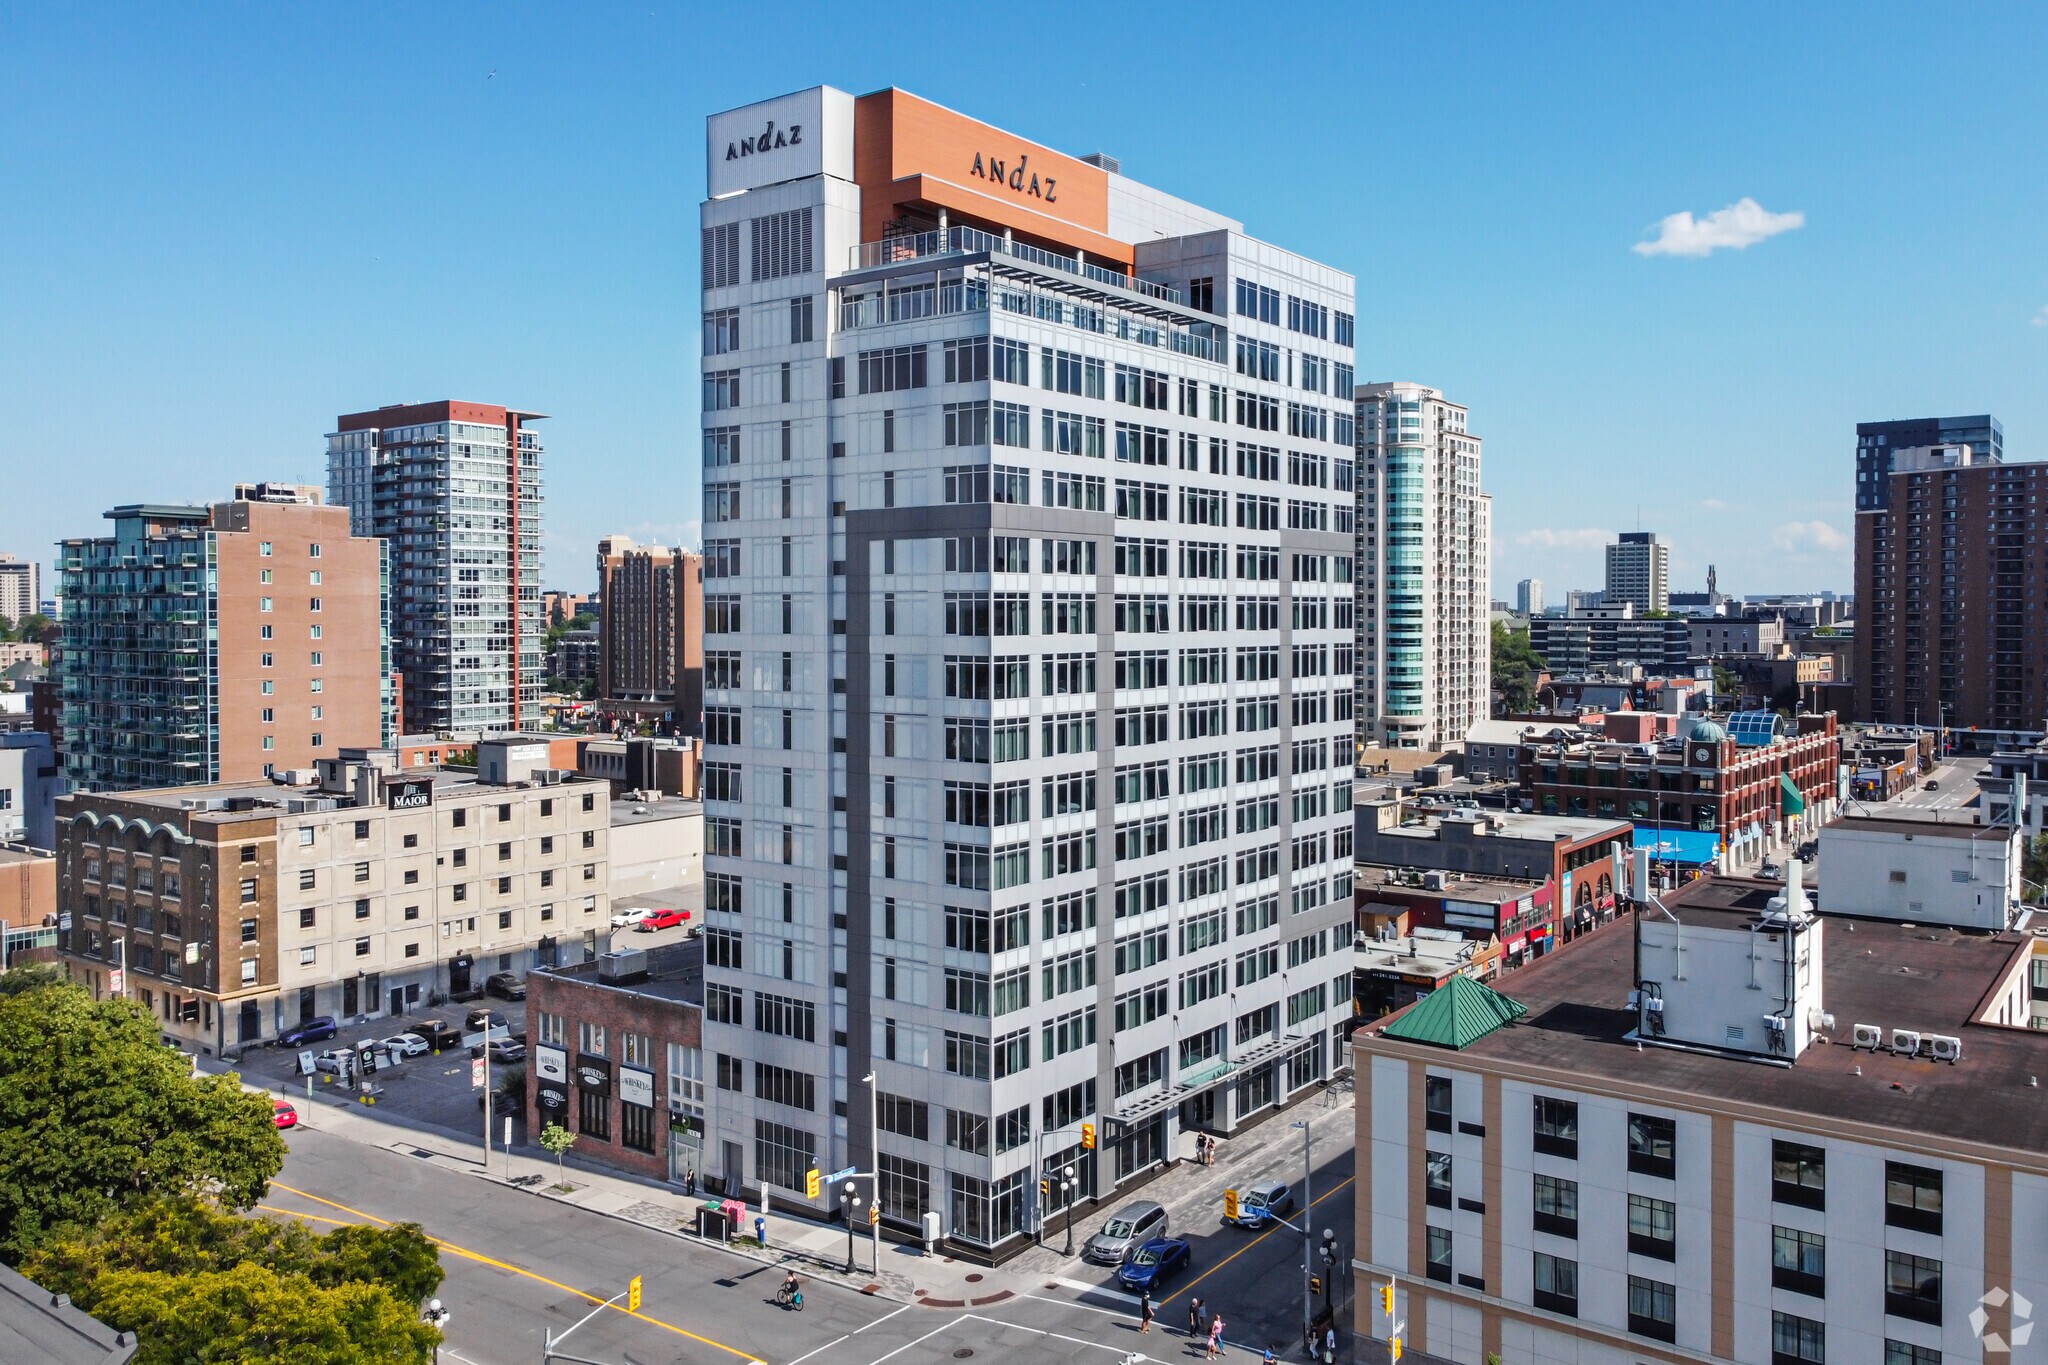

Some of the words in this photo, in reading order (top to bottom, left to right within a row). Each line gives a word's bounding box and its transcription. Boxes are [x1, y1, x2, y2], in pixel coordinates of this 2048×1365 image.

[393, 795, 428, 807] MAJOR
[581, 1066, 603, 1080] WHISKEY
[624, 1077, 645, 1091] WHISKEY
